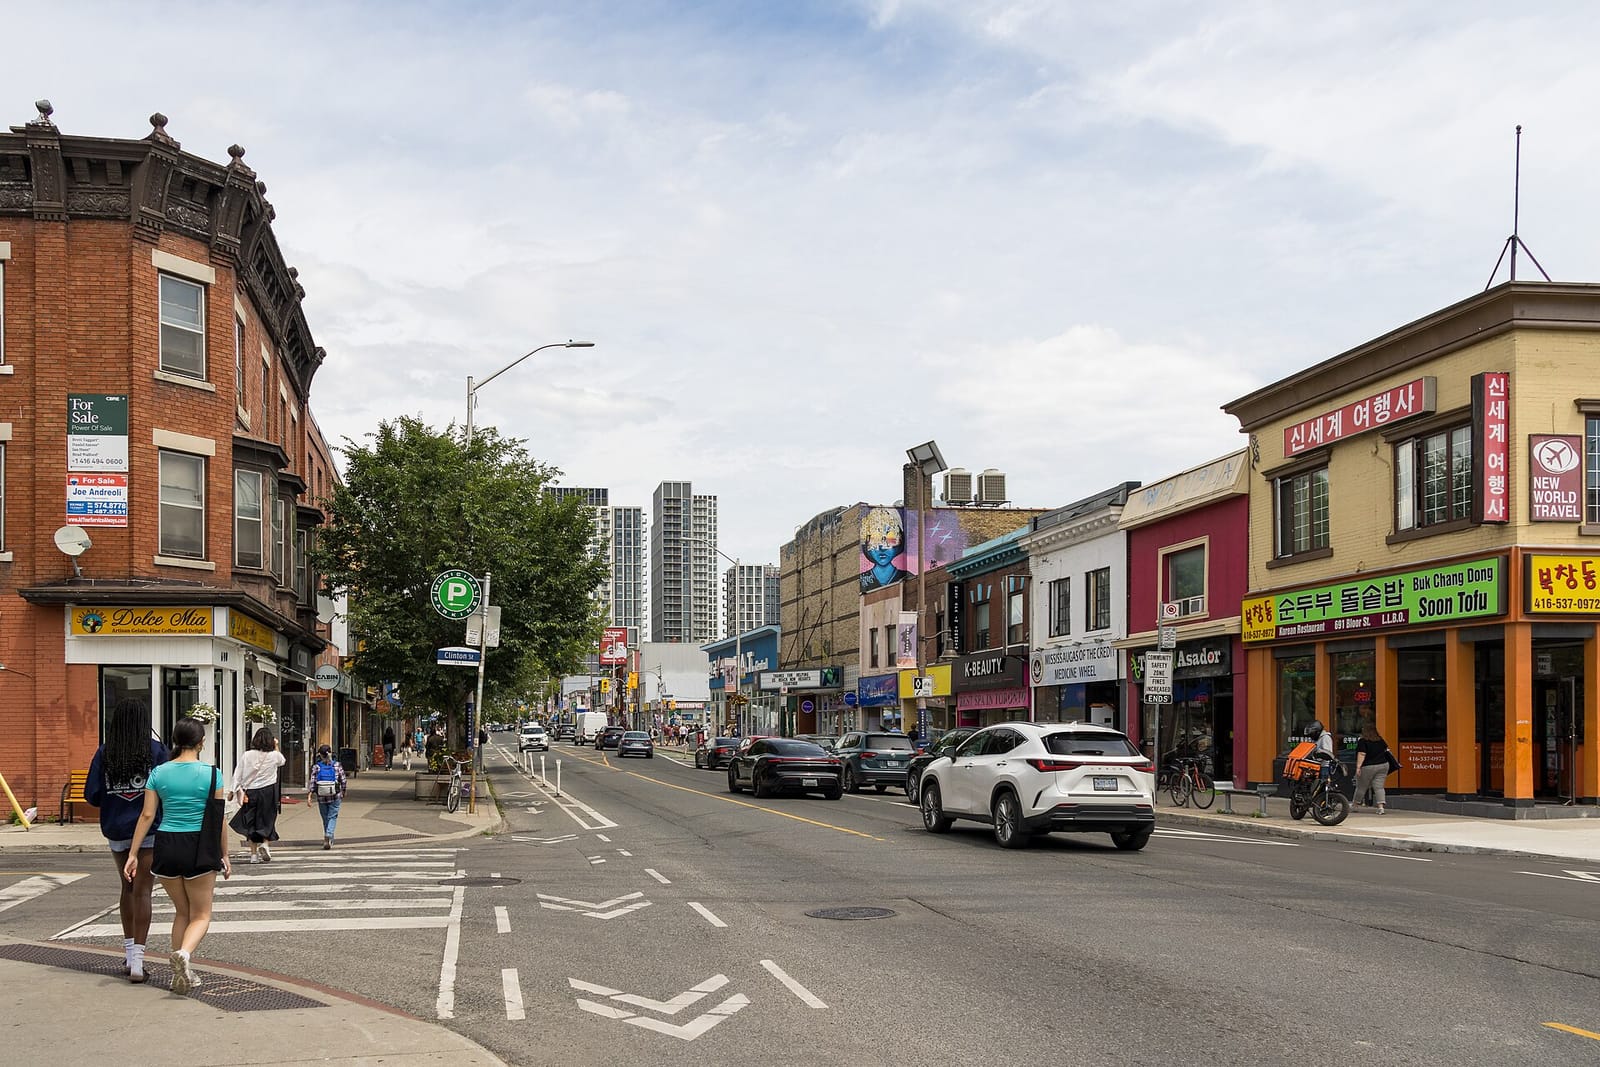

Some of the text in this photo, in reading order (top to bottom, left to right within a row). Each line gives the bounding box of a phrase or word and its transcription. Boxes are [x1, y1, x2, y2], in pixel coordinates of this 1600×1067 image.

[72, 398, 94, 410] For
[72, 411, 99, 423] Sale
[1290, 384, 1415, 453] 신세계 여행사
[1488, 377, 1505, 518] 신세계 여행사
[89, 488, 122, 496] Andreoli
[1534, 477, 1560, 490] NEW
[1534, 491, 1577, 504] WORLD
[1534, 505, 1580, 518] TRAVEL
[434, 572, 479, 594] MUNICIPAL
[1413, 567, 1493, 591] Buk Chang Dong
[1538, 560, 1597, 596] 북창동
[434, 596, 477, 617] PARKING
[1278, 579, 1404, 621] 순두부 돌솥밥
[1418, 590, 1487, 618] Soon Tofu
[1534, 598, 1600, 610] 416-537-0972
[111, 608, 207, 626] Dolce Mia
[1245, 600, 1273, 628] 북창동
[1279, 612, 1406, 636] Korean Restaurant 691 Bloor St. L.L.B.O.
[444, 652, 467, 660] Clinton
[1045, 646, 1114, 664] MISSISSAUGAS OF THE CREDIT
[1177, 648, 1221, 667] Asador
[1055, 665, 1096, 680] MEDICINE WHEEL
